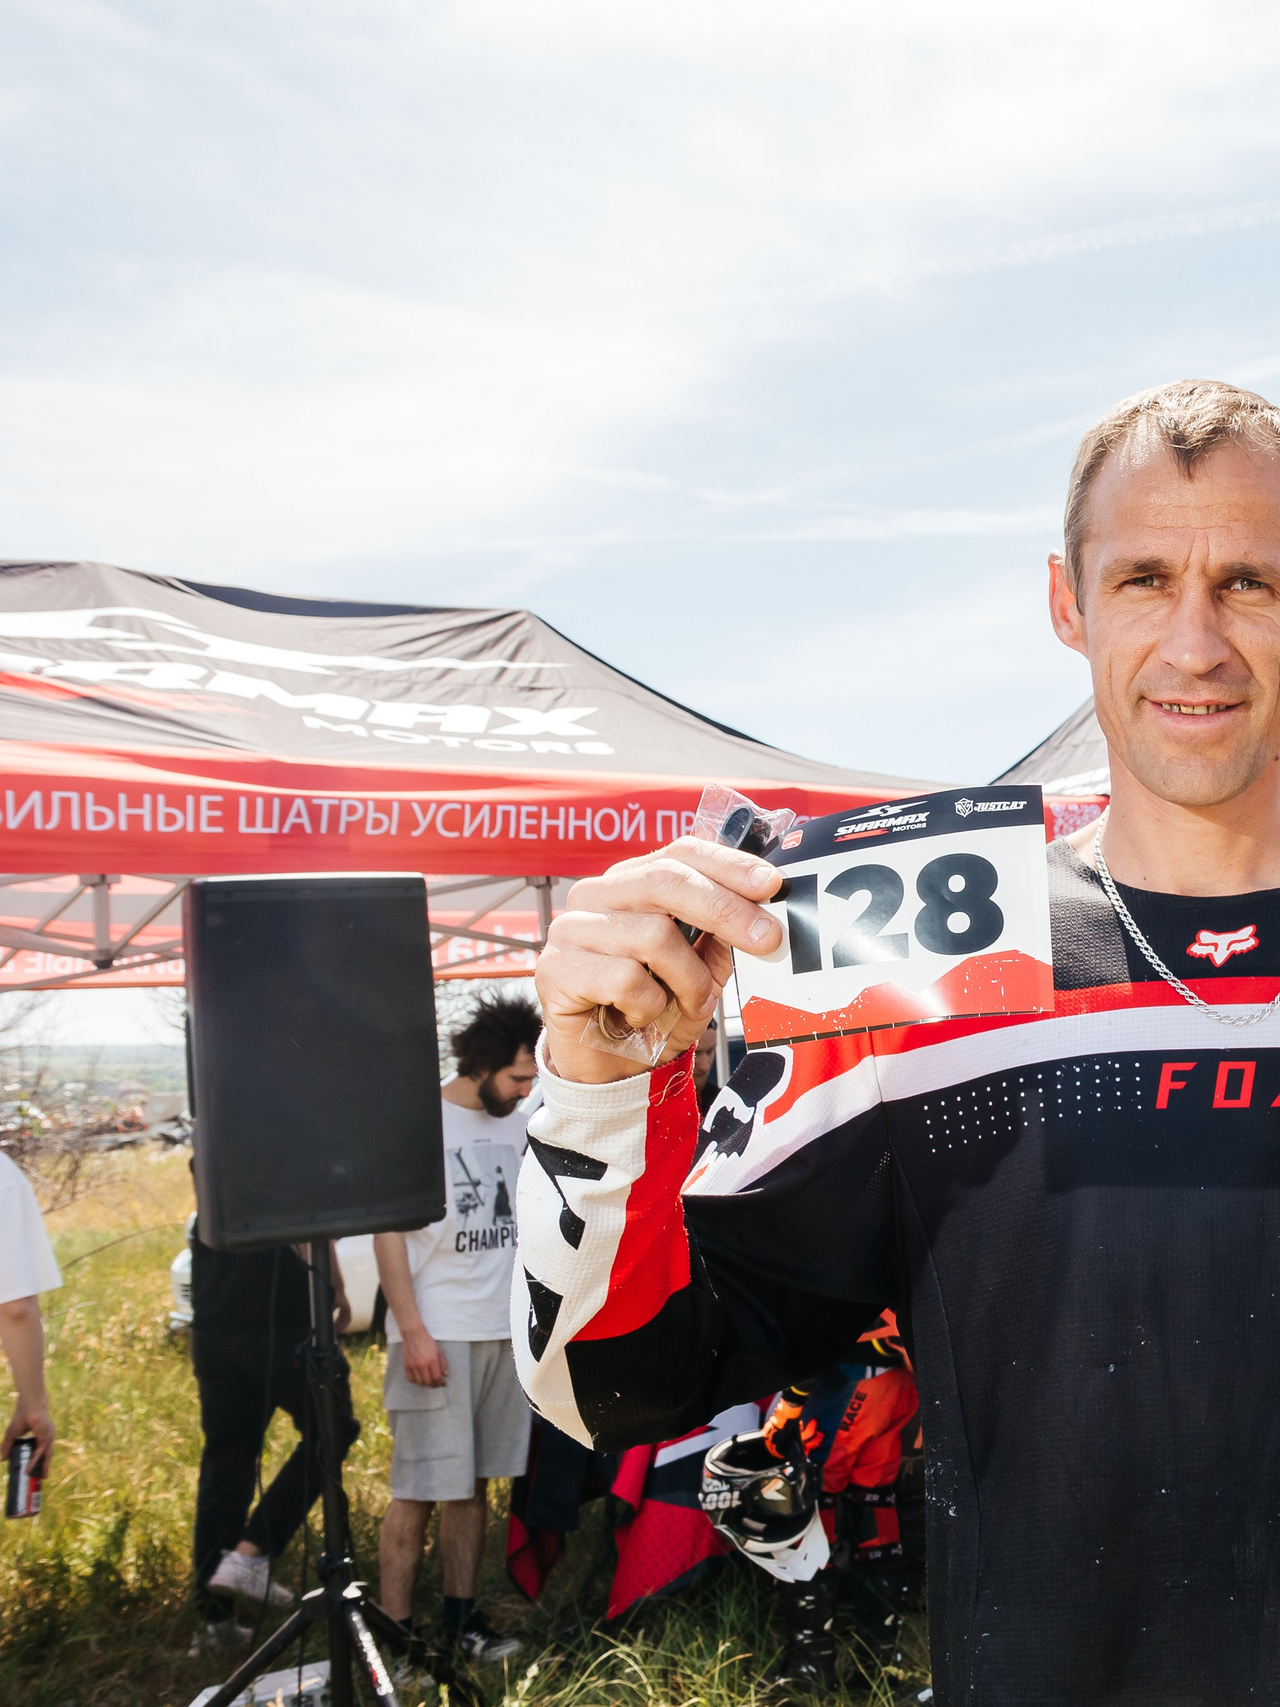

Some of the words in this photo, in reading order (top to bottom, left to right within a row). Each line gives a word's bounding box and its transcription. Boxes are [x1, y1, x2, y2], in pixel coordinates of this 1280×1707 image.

[302, 715, 616, 756] MOTORS
[0, 788, 224, 834] ИЛЬНЫЕ
[238, 796, 399, 837] ШАТРЫ
[410, 802, 646, 842] УСИЛЕННОЙ
[834, 811, 931, 837] SHARMAX
[974, 800, 1028, 813] JUSTCAT
[892, 822, 928, 833] MOTORS
[769, 852, 1005, 975] 128
[840, 1389, 868, 1433] RACE
